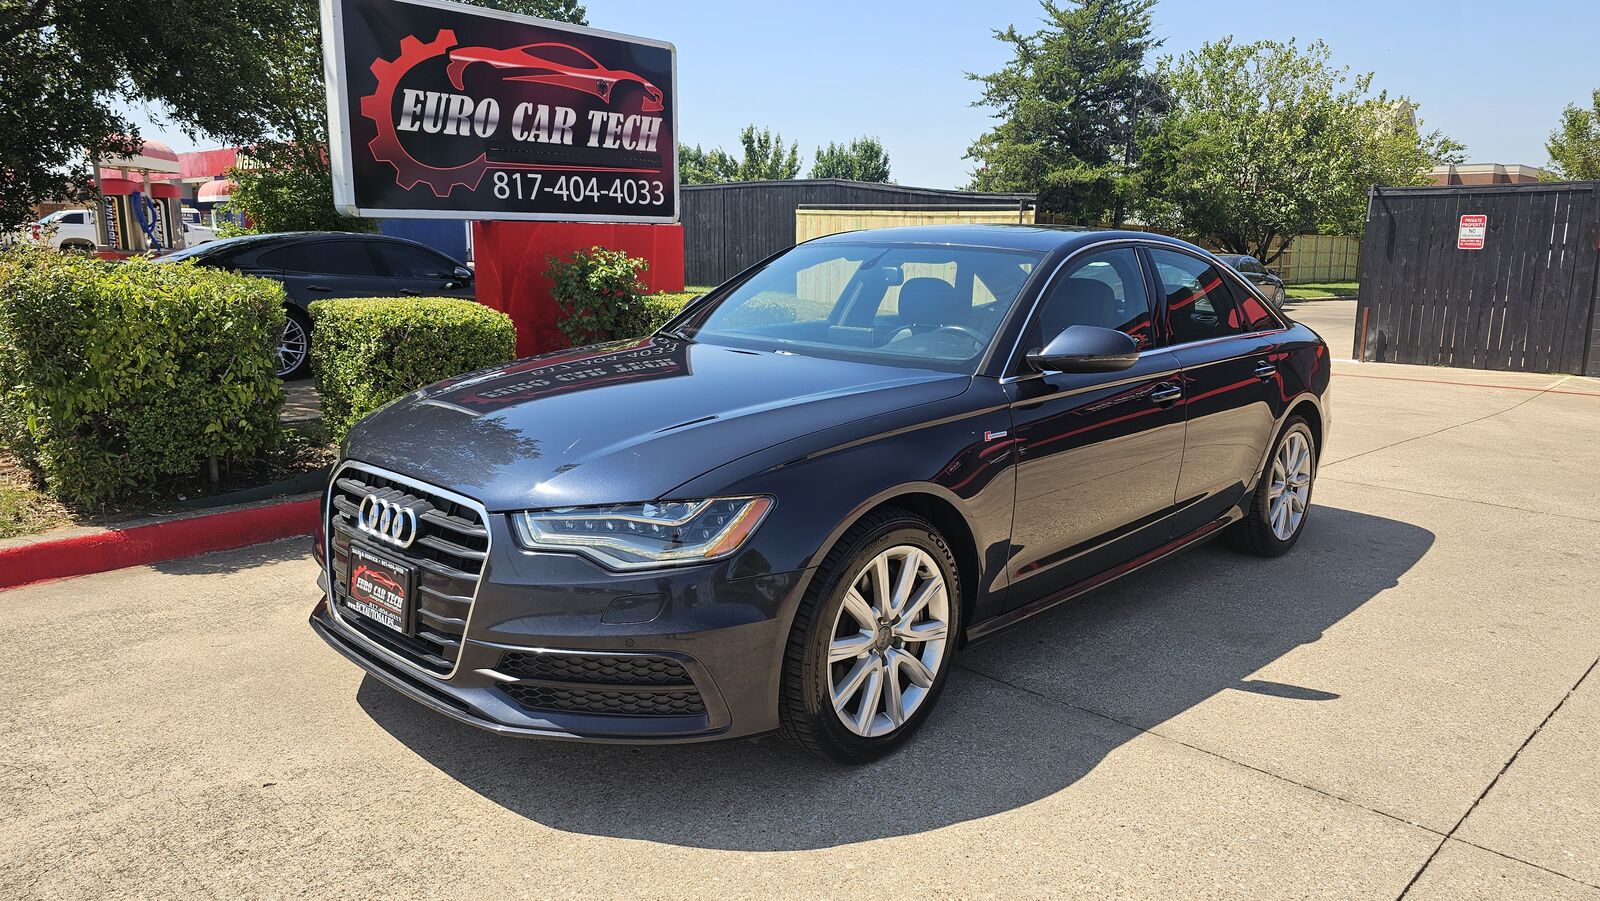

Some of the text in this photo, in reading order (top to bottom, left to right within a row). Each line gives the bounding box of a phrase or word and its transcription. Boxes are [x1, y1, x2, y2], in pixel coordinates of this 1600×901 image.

[397, 88, 663, 152] EURO CAR TECH
[493, 171, 665, 206] 817-404-4033
[356, 577, 404, 609] EURO CAR TECH
